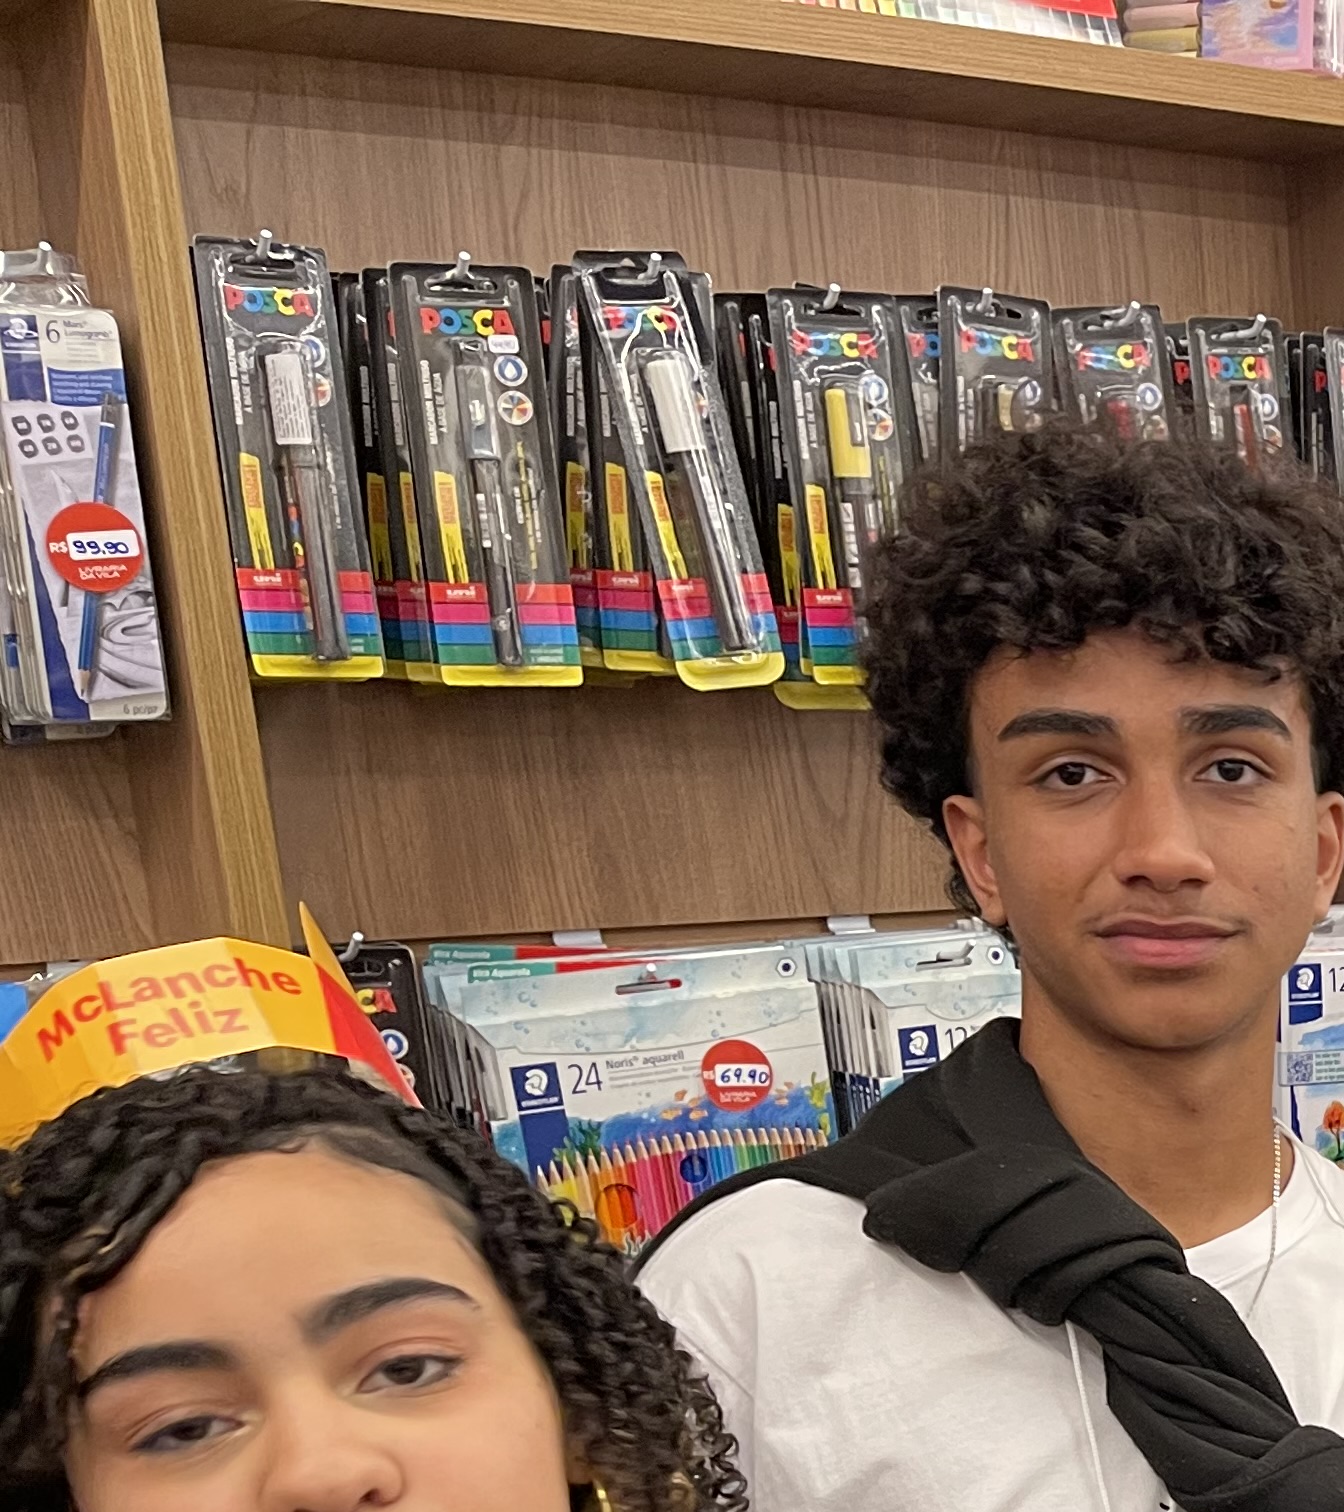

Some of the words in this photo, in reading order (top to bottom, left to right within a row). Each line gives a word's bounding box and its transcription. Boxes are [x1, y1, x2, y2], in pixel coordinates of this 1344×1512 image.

[224, 285, 314, 317] POSCA
[46, 320, 61, 343] 6
[420, 307, 517, 336] POSCA
[1208, 355, 1271, 381] POSCA
[49, 542, 68, 553] R$
[253, 573, 282, 585] uni
[446, 586, 476, 600] uni
[37, 957, 303, 1062] McLanche
[108, 1001, 249, 1056] Feliz
[567, 1062, 604, 1095] 24
[642, 1050, 685, 1067] aquarell
